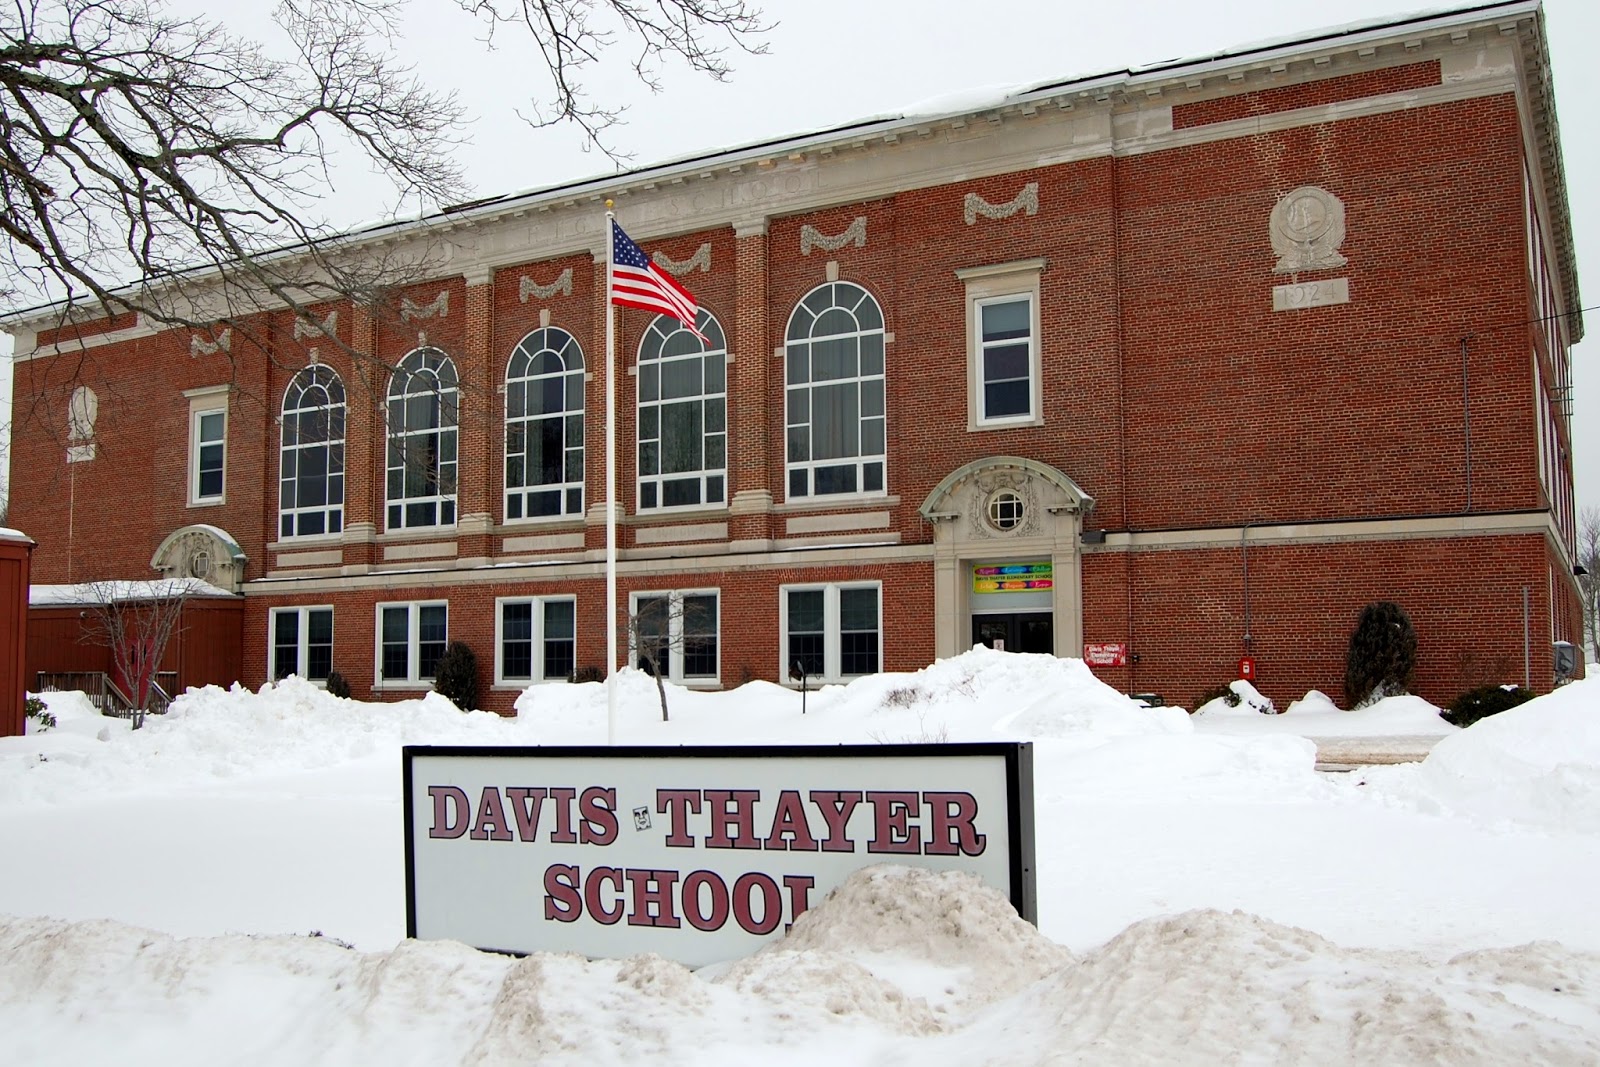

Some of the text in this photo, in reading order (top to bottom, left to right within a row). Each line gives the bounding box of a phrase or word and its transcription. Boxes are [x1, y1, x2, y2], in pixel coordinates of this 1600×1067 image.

[671, 171, 829, 215] SCHOOL
[1283, 283, 1337, 305] 1924
[428, 786, 986, 857] DAVIS THAYER
